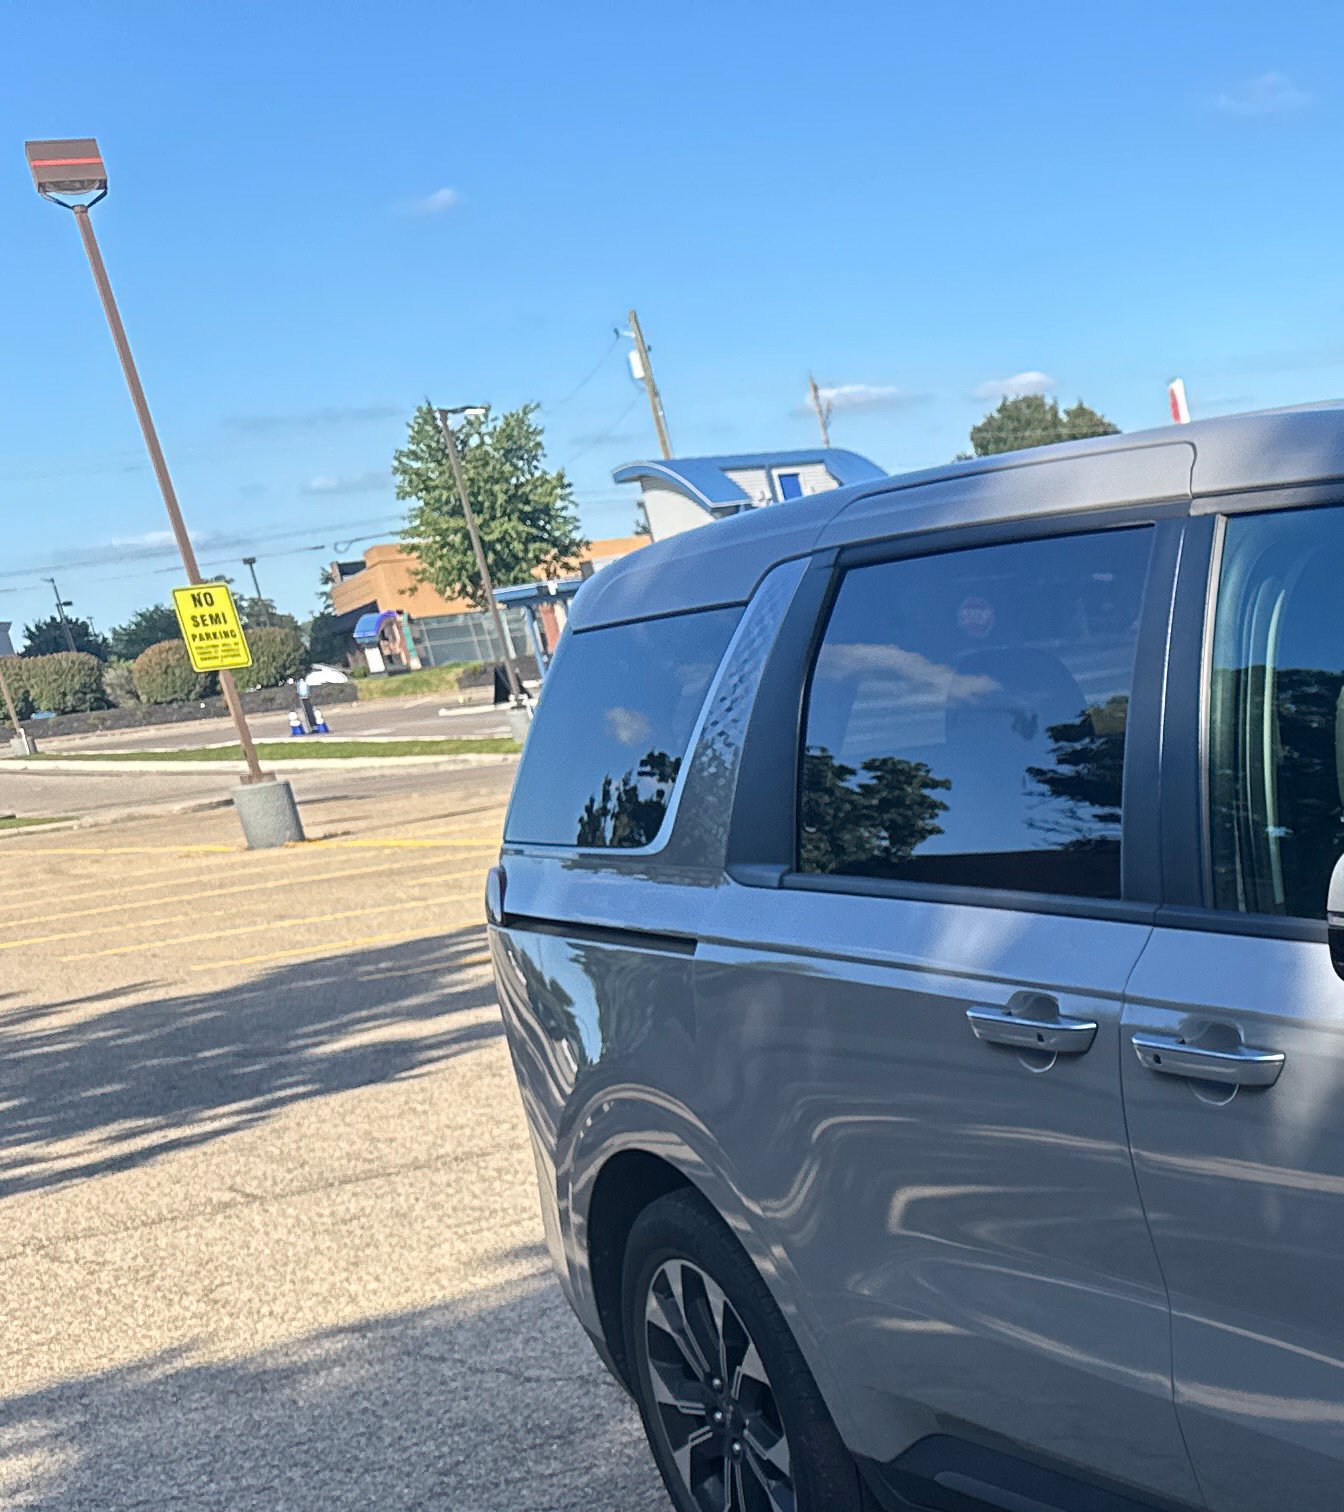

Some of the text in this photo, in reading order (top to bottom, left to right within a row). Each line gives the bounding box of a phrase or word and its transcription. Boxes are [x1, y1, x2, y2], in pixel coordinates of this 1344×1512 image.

[191, 591, 215, 608] NO
[190, 612, 228, 628] SEMI
[191, 629, 237, 642] PARKING
